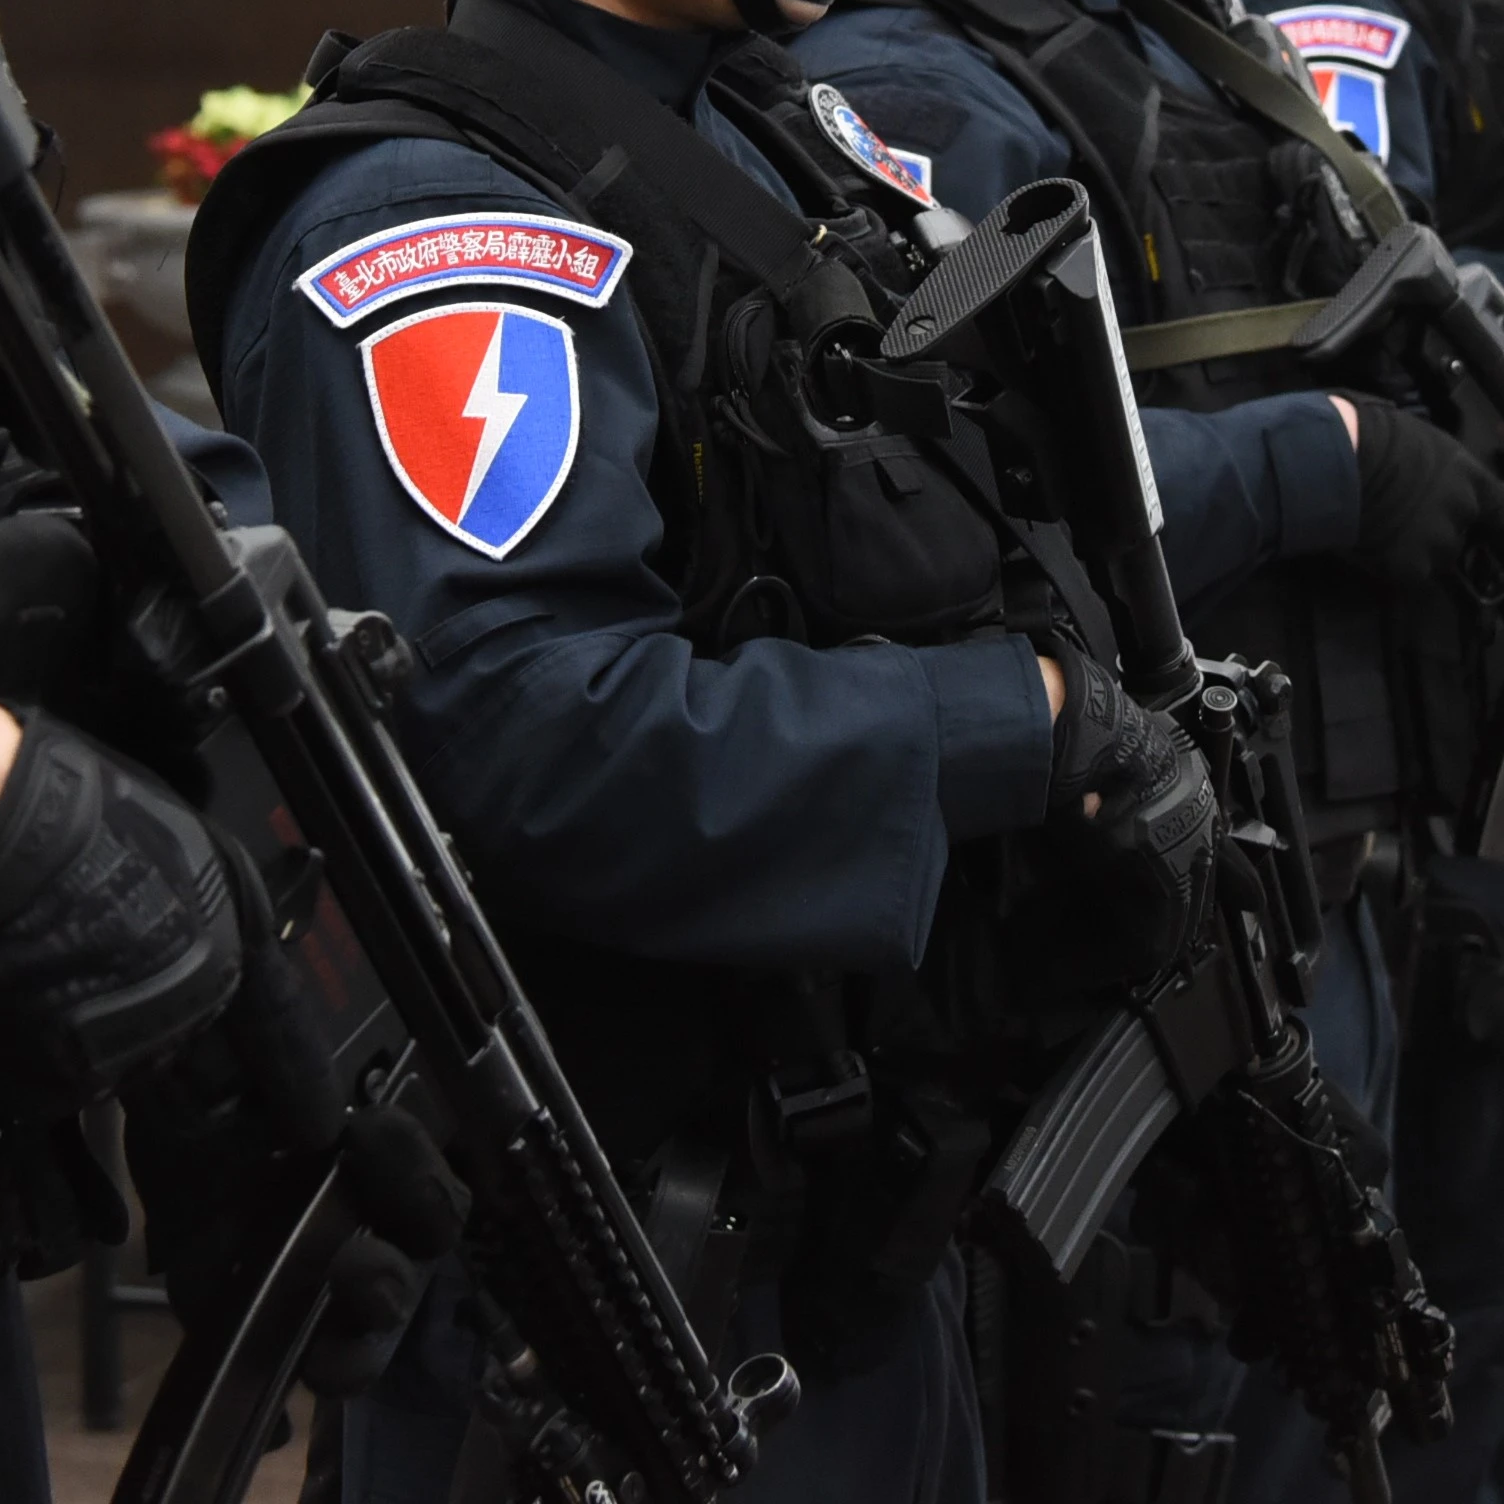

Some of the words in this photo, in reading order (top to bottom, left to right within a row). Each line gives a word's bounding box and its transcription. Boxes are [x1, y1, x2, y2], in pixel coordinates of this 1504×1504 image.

[333, 229, 600, 305] 臺北市政府警察局霹靂小組
